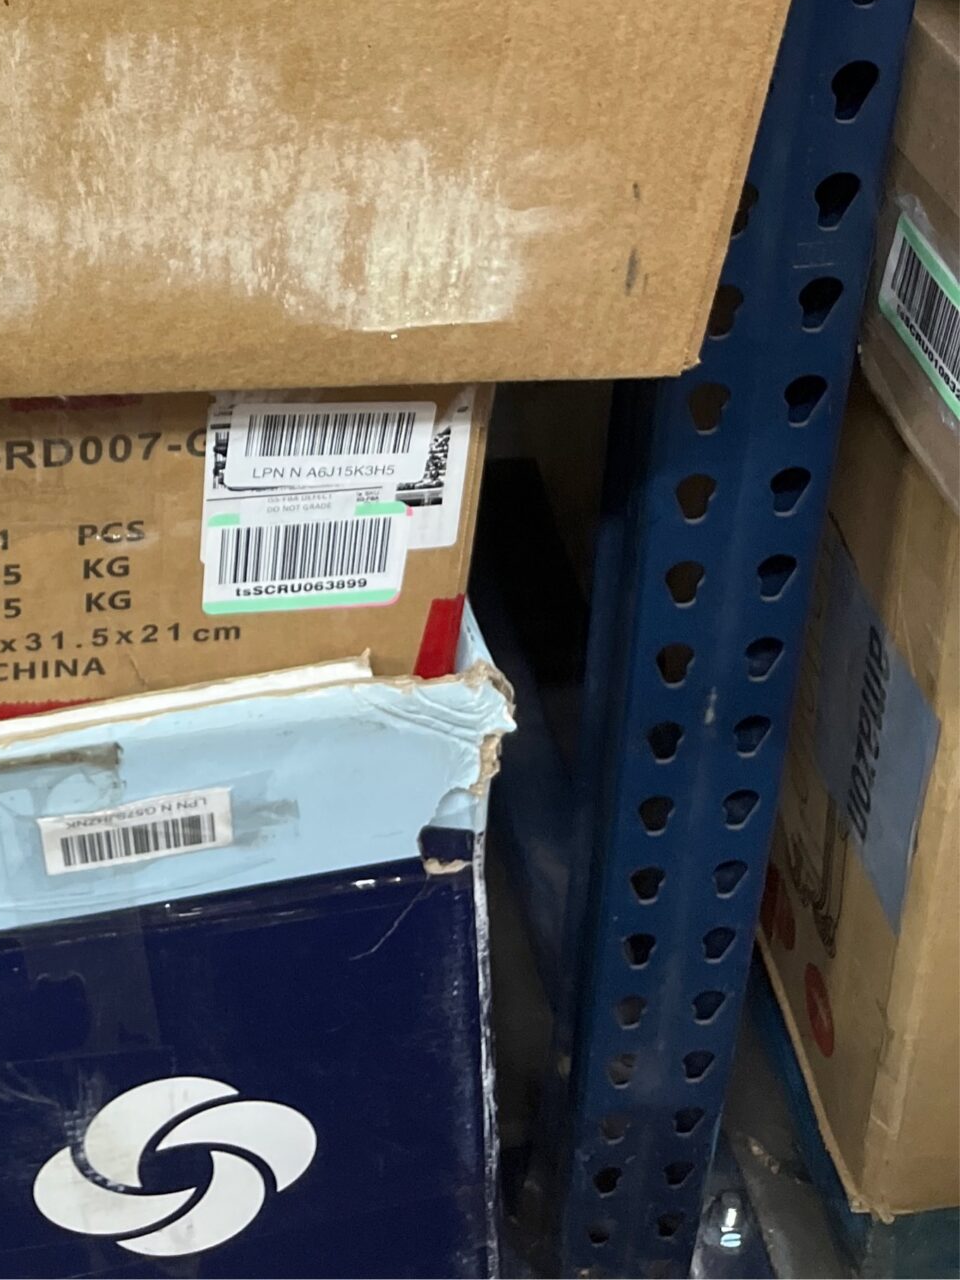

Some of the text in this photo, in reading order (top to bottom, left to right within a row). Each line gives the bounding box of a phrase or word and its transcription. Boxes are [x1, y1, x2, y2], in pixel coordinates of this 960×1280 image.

[252, 464, 395, 479] LPN N A6J15K3H5
[267, 505, 279, 513] DO
[283, 504, 300, 512] NOT
[78, 521, 146, 546] PCS
[83, 556, 131, 579] KG
[235, 578, 367, 597] tsSCRU063899
[84, 591, 132, 613] KG
[847, 625, 891, 844] amazon
[161, 803, 172, 811] N
[177, 797, 207, 809] LPN
